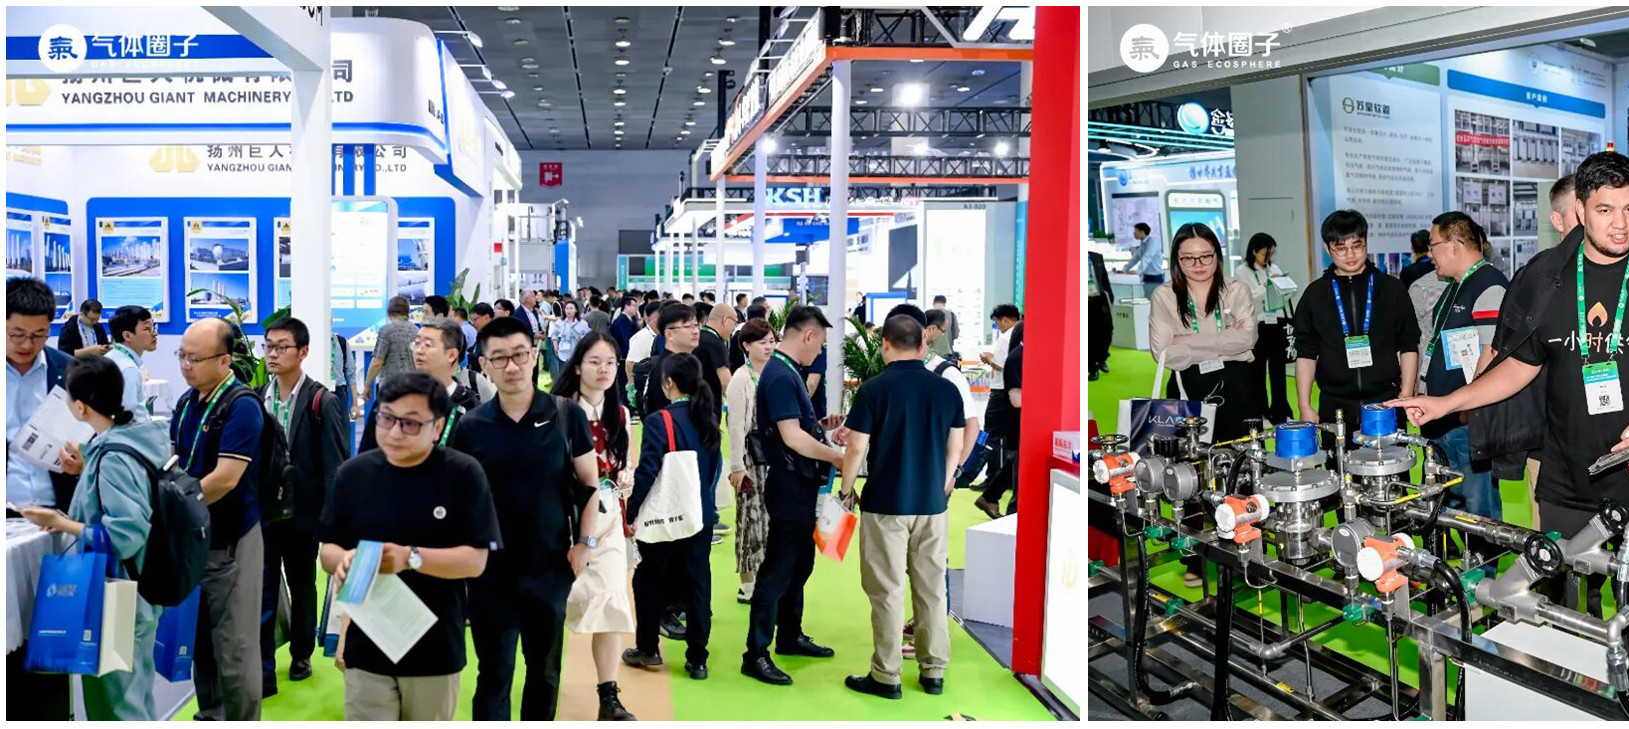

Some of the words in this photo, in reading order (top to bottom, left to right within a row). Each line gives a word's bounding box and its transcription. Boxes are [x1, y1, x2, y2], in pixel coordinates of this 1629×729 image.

[62, 92, 145, 104] YANGZHOU
[149, 92, 196, 104] GIANT
[204, 91, 292, 103] MACHINERY
[207, 164, 265, 172] YANGZHOU
[268, 164, 293, 172] GIAN
[766, 187, 822, 205] KSH
